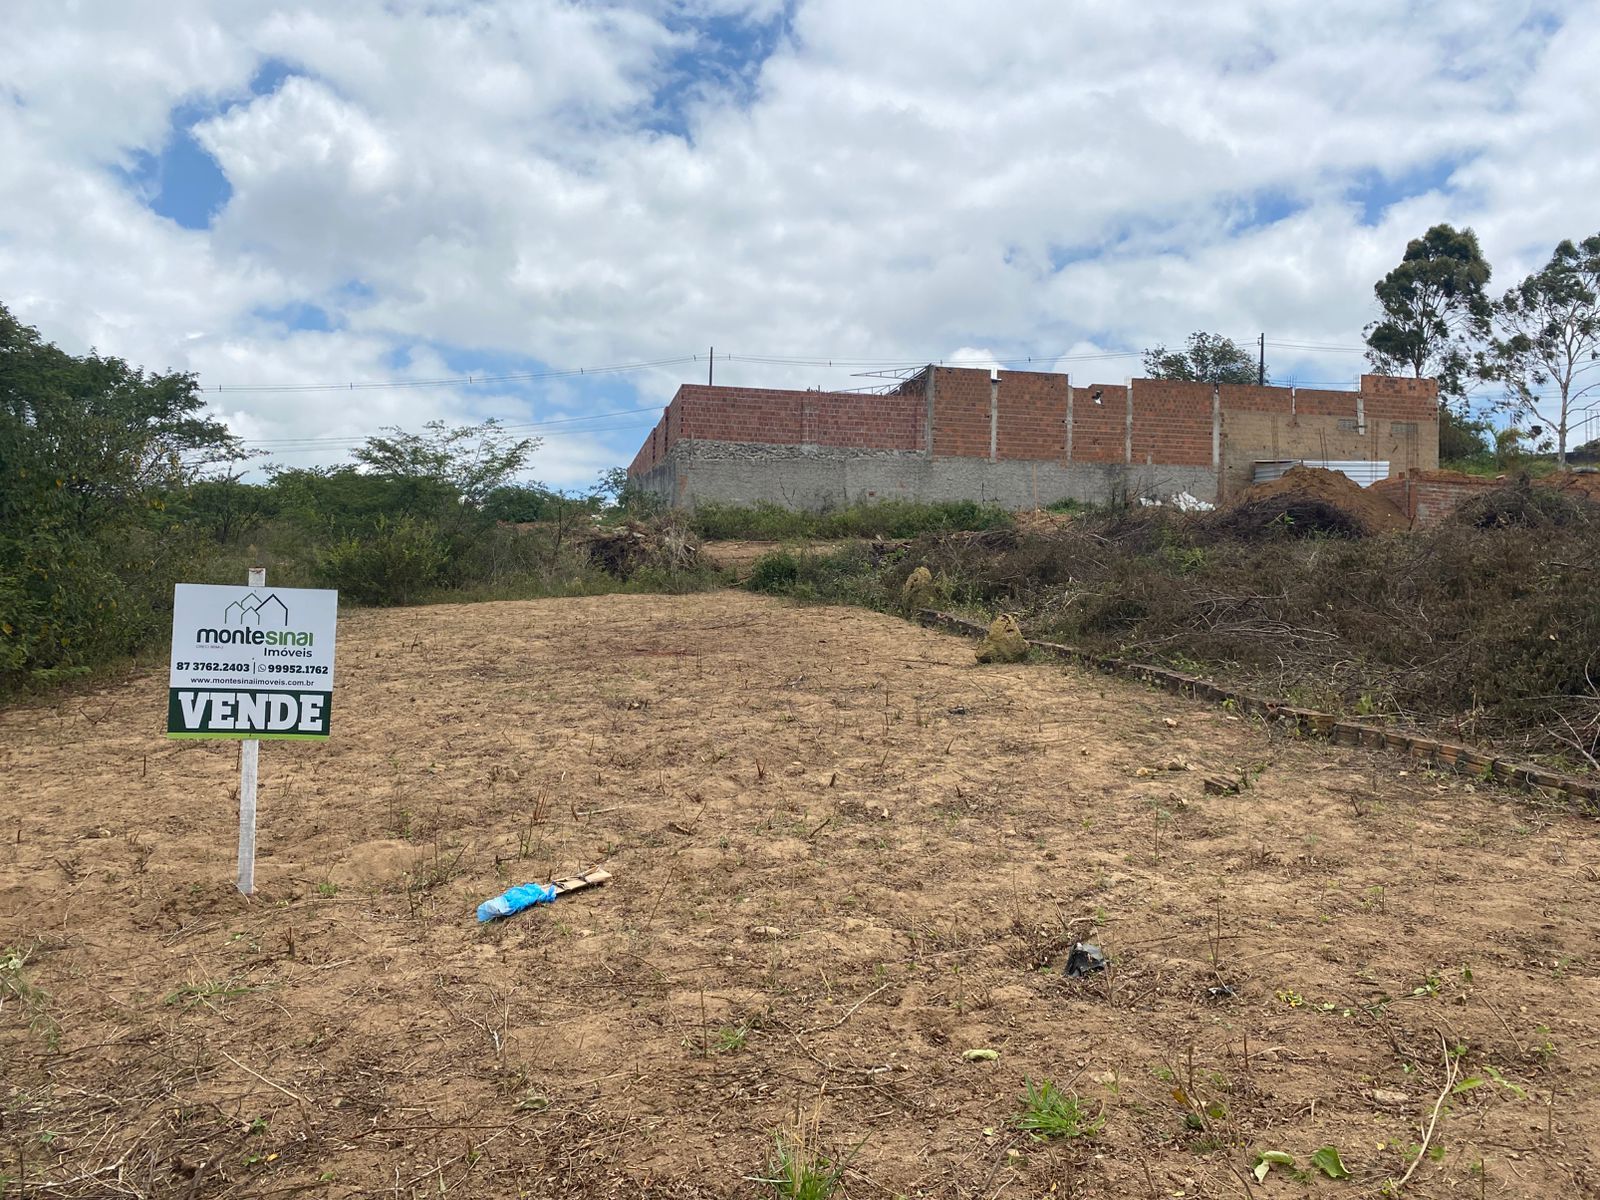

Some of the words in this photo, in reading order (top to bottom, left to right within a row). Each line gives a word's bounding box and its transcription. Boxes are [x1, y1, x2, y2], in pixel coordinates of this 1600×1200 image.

[264, 647, 313, 658] Imóveis
[176, 662, 190, 671] 87
[193, 662, 250, 672] 3762.2403
[268, 664, 329, 675] 99952.1762
[190, 677, 315, 687] www.montesinaiimoveis.com.br
[177, 691, 325, 732] VENDE
